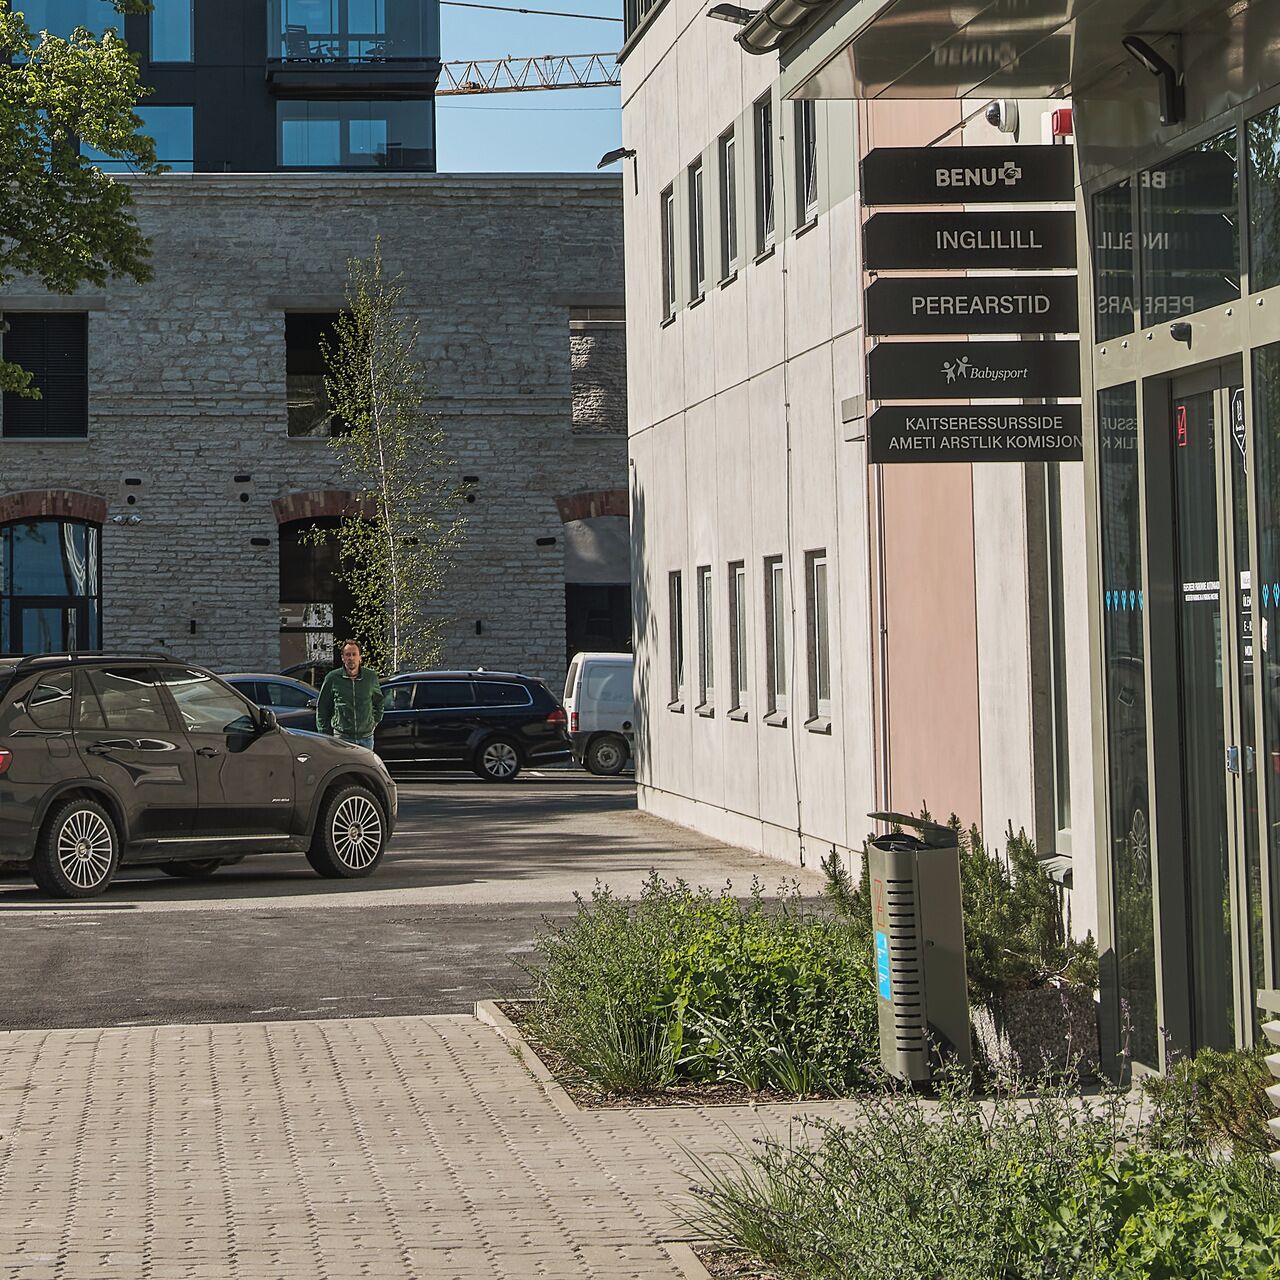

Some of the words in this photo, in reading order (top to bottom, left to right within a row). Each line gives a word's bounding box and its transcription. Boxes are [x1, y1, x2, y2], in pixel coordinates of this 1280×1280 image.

[936, 167, 997, 187] BENU
[936, 230, 1042, 249] INGLILILL
[912, 295, 1051, 315] PEREARSTID
[970, 366, 1028, 382] Babysport
[905, 416, 1063, 431] KAITSERESSURSSIDE
[888, 436, 936, 450] AMETI
[939, 436, 1003, 450] ARSTLIK
